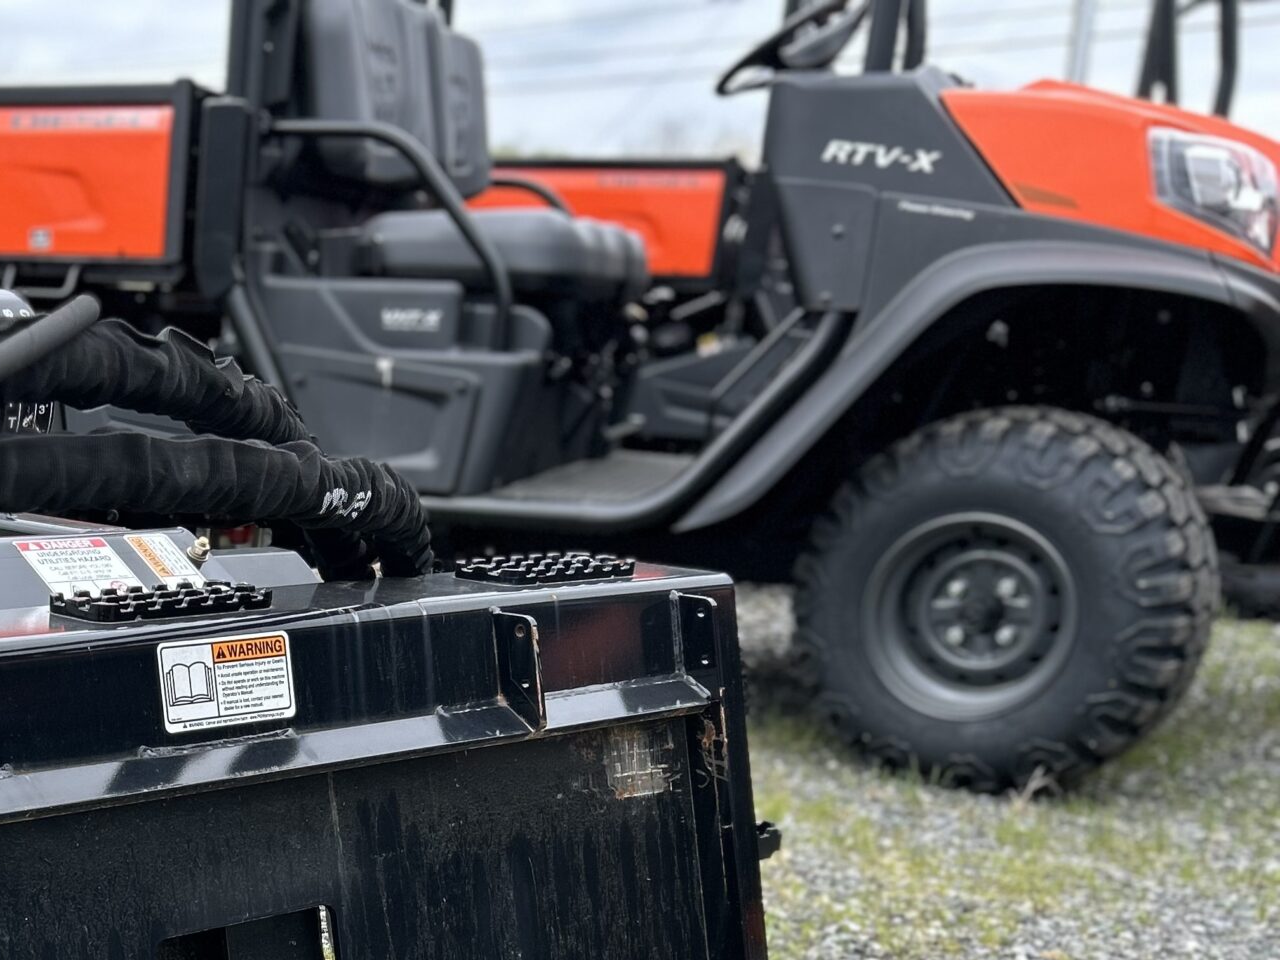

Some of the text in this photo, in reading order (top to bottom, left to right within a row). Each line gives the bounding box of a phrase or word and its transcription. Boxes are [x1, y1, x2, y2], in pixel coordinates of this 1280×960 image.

[821, 138, 942, 174] RTV-X
[43, 539, 95, 550] DANGER
[78, 555, 112, 563] HAZARD
[227, 639, 283, 657] WARNING
